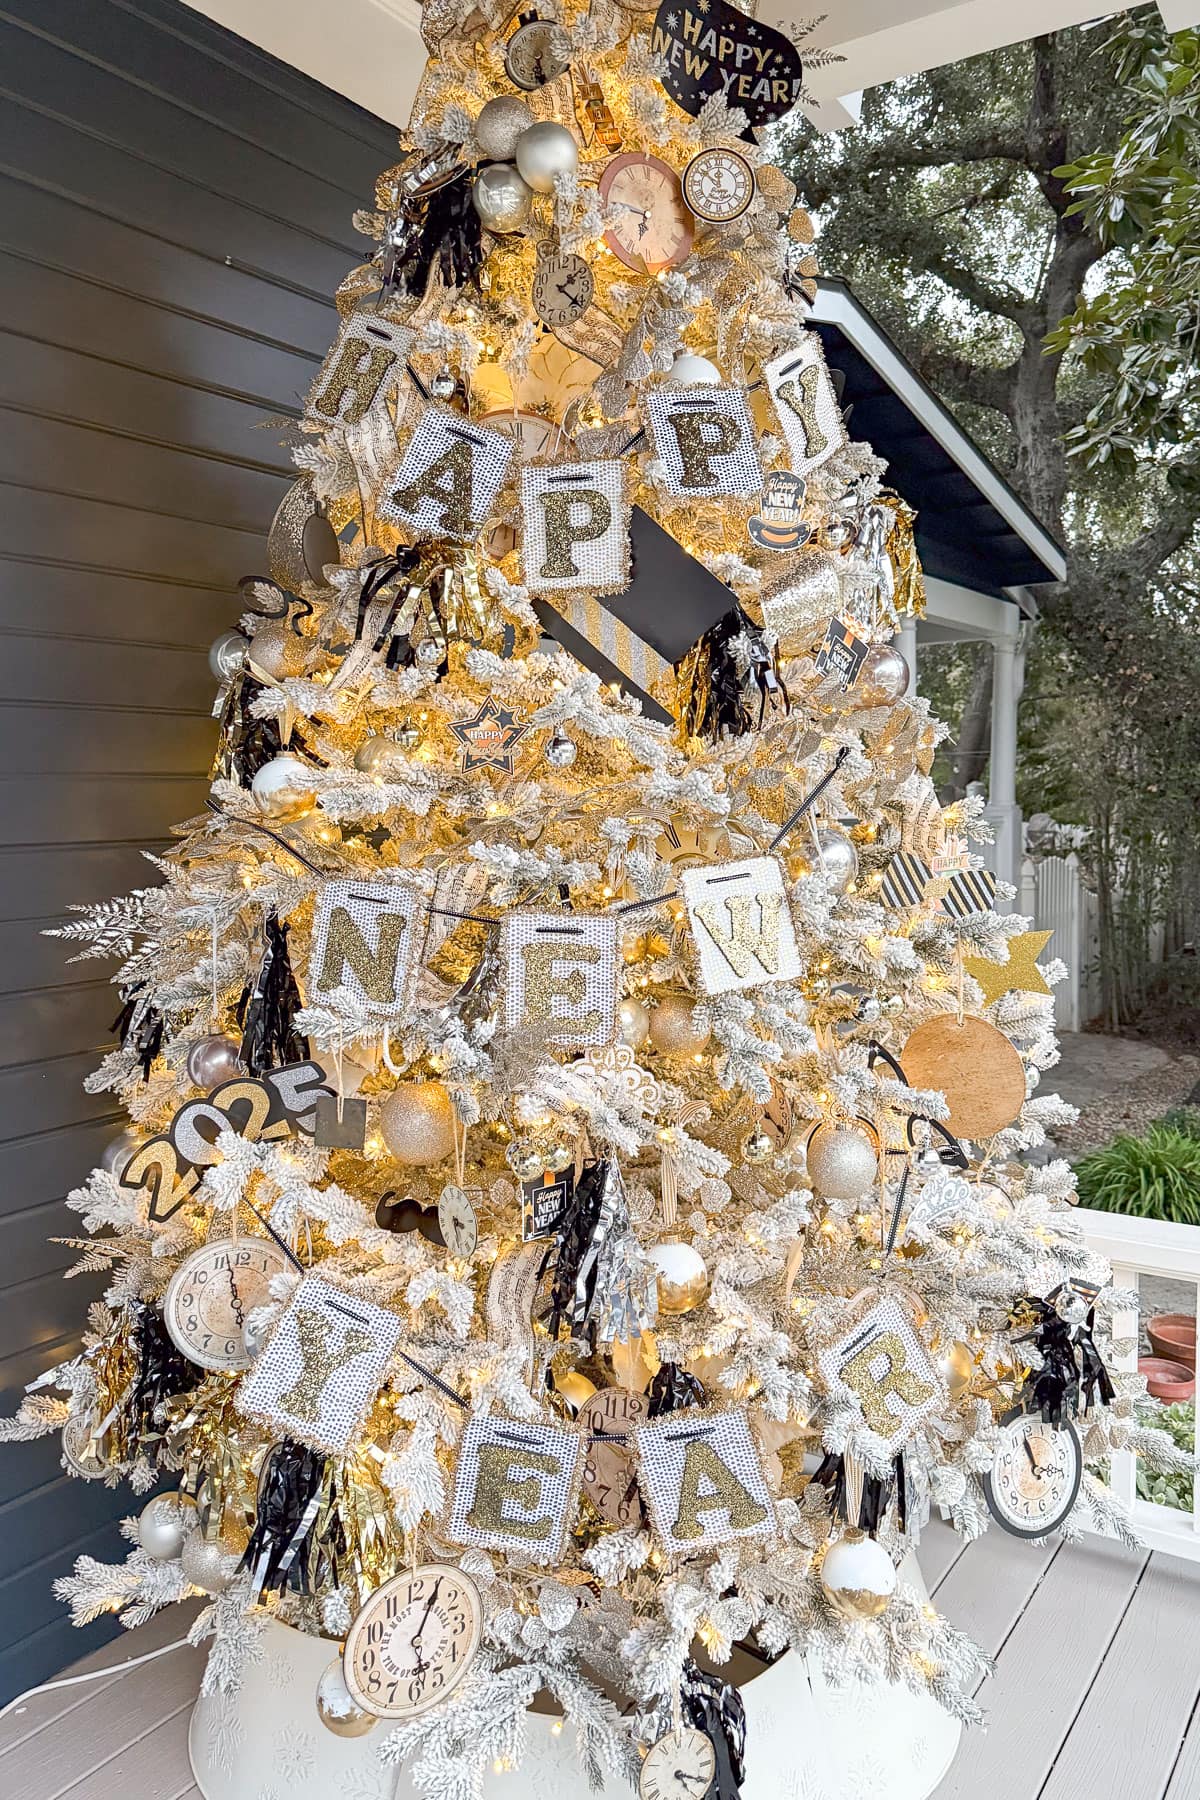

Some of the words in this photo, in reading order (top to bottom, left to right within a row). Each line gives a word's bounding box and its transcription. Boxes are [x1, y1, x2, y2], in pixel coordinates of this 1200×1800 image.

[683, 8, 774, 73] HAPPY
[652, 26, 710, 81] NEW
[719, 67, 802, 104] YEAR!
[548, 261, 555, 274] 11
[558, 255, 569, 269] 12
[573, 258, 577, 271] 1
[536, 273, 548, 286] 10
[579, 267, 587, 279] 2
[536, 286, 543, 299] 9
[581, 279, 590, 293] 3
[538, 300, 546, 313] 8
[548, 309, 556, 321] 7
[559, 310, 567, 323] 6
[768, 477, 799, 494] Happy
[768, 491, 796, 508] NEW
[763, 506, 800, 523] YEAR!
[831, 651, 850, 671] NEW
[470, 730, 505, 740] HAPPY
[937, 857, 964, 868] HAPPY
[121, 1061, 334, 1222] 2025
[536, 1188, 562, 1204] Happy
[538, 1198, 561, 1216] NEW
[214, 1256, 225, 1270] 11
[234, 1252, 251, 1266] 12
[262, 1259, 268, 1273] 1
[192, 1270, 208, 1285] 10
[182, 1293, 194, 1308] 9
[186, 1314, 198, 1332] 8
[202, 1334, 213, 1349] 7
[225, 1340, 236, 1355] 6
[604, 1395, 617, 1419] 11
[622, 1397, 643, 1422] 12
[584, 1409, 604, 1432] 10
[1002, 1453, 1012, 1467] 10
[583, 1460, 597, 1483] 8
[1002, 1476, 1010, 1489] 9
[597, 1484, 612, 1507] 7
[1010, 1491, 1019, 1506] 8
[1051, 1487, 1059, 1501] 5
[617, 1500, 630, 1522] 6
[1023, 1501, 1031, 1516] 7
[1038, 1499, 1047, 1512] 6
[408, 1579, 425, 1605] 12
[447, 1589, 459, 1612] 2
[386, 1595, 397, 1619] 11
[367, 1620, 384, 1645] 10
[380, 1631, 393, 1653] THE
[389, 1606, 412, 1631] MOST
[453, 1613, 466, 1635] 3
[362, 1648, 376, 1672] 9
[445, 1641, 459, 1663] 4
[382, 1655, 400, 1676] TIME
[367, 1670, 381, 1694] 8
[432, 1665, 444, 1688] 5
[387, 1680, 399, 1704] 7
[408, 1679, 421, 1702] 6
